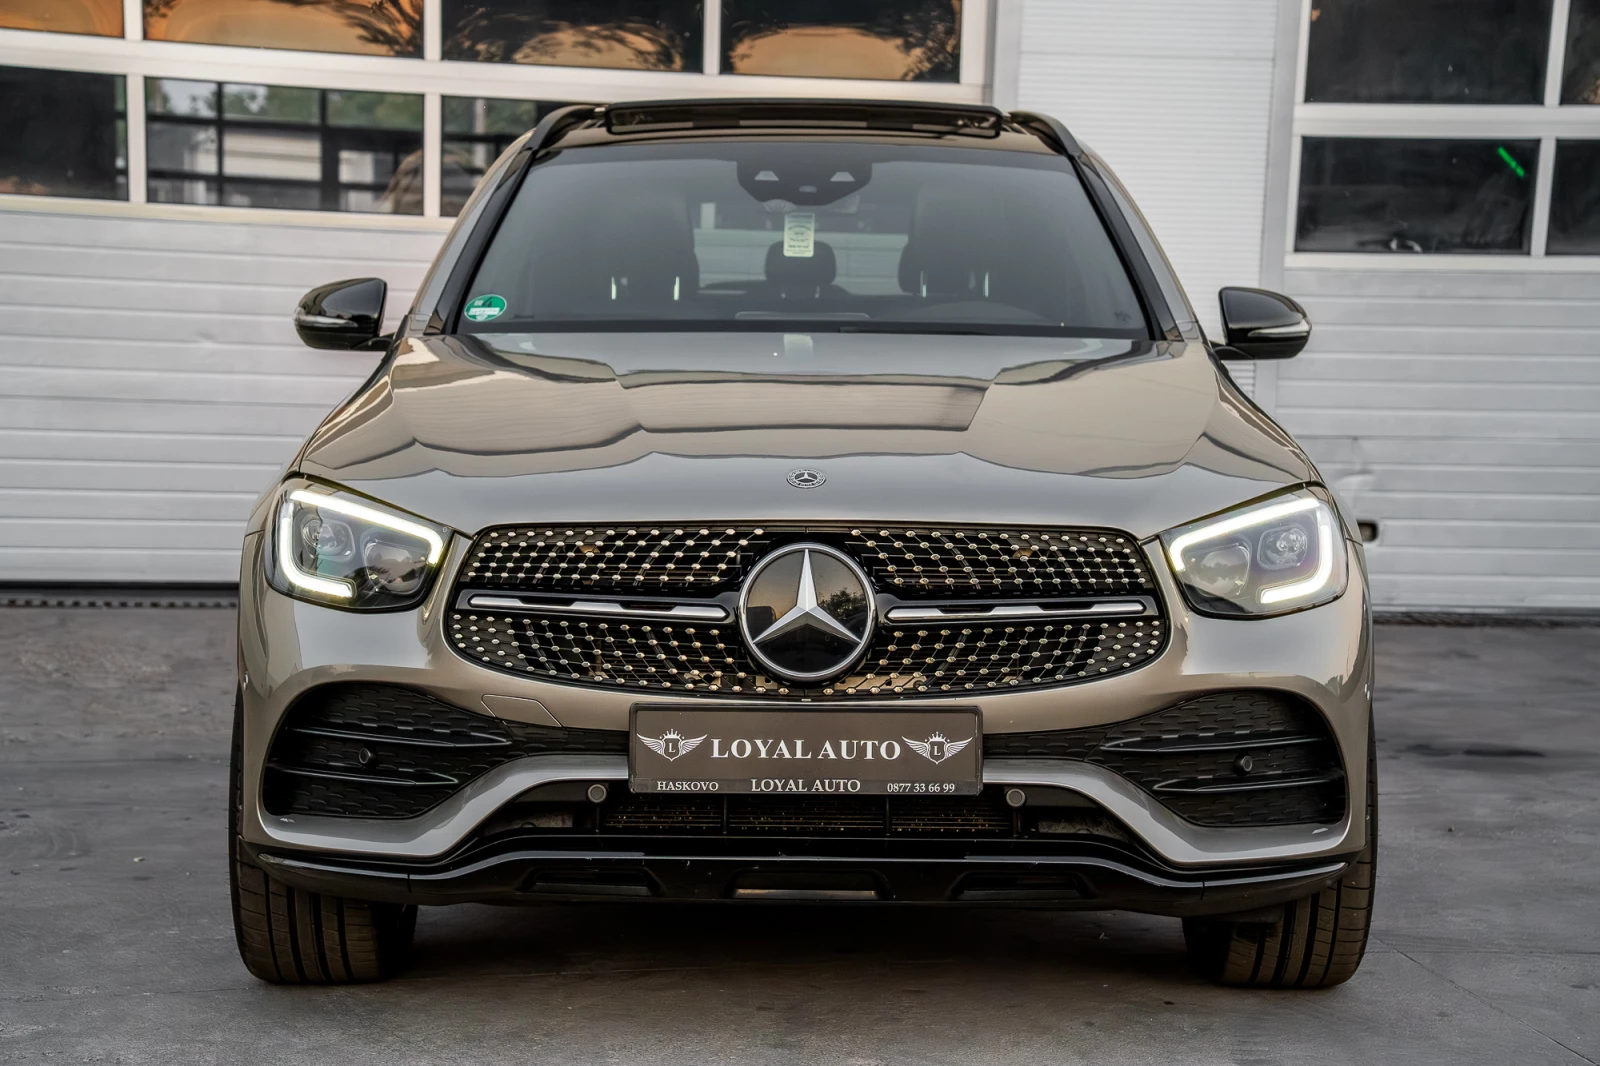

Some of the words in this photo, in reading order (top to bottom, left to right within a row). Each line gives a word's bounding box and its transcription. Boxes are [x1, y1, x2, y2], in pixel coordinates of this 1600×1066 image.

[668, 742, 676, 753] L
[710, 738, 812, 759] LOYAL
[817, 739, 901, 760] AUTO
[933, 745, 942, 756] L
[656, 781, 719, 792] HASKOVO
[751, 779, 807, 792] LOYAL
[811, 779, 861, 793] AUTO
[887, 783, 912, 793] 0877
[914, 783, 926, 793] 33
[928, 783, 940, 793] 66
[942, 783, 955, 793] 99
